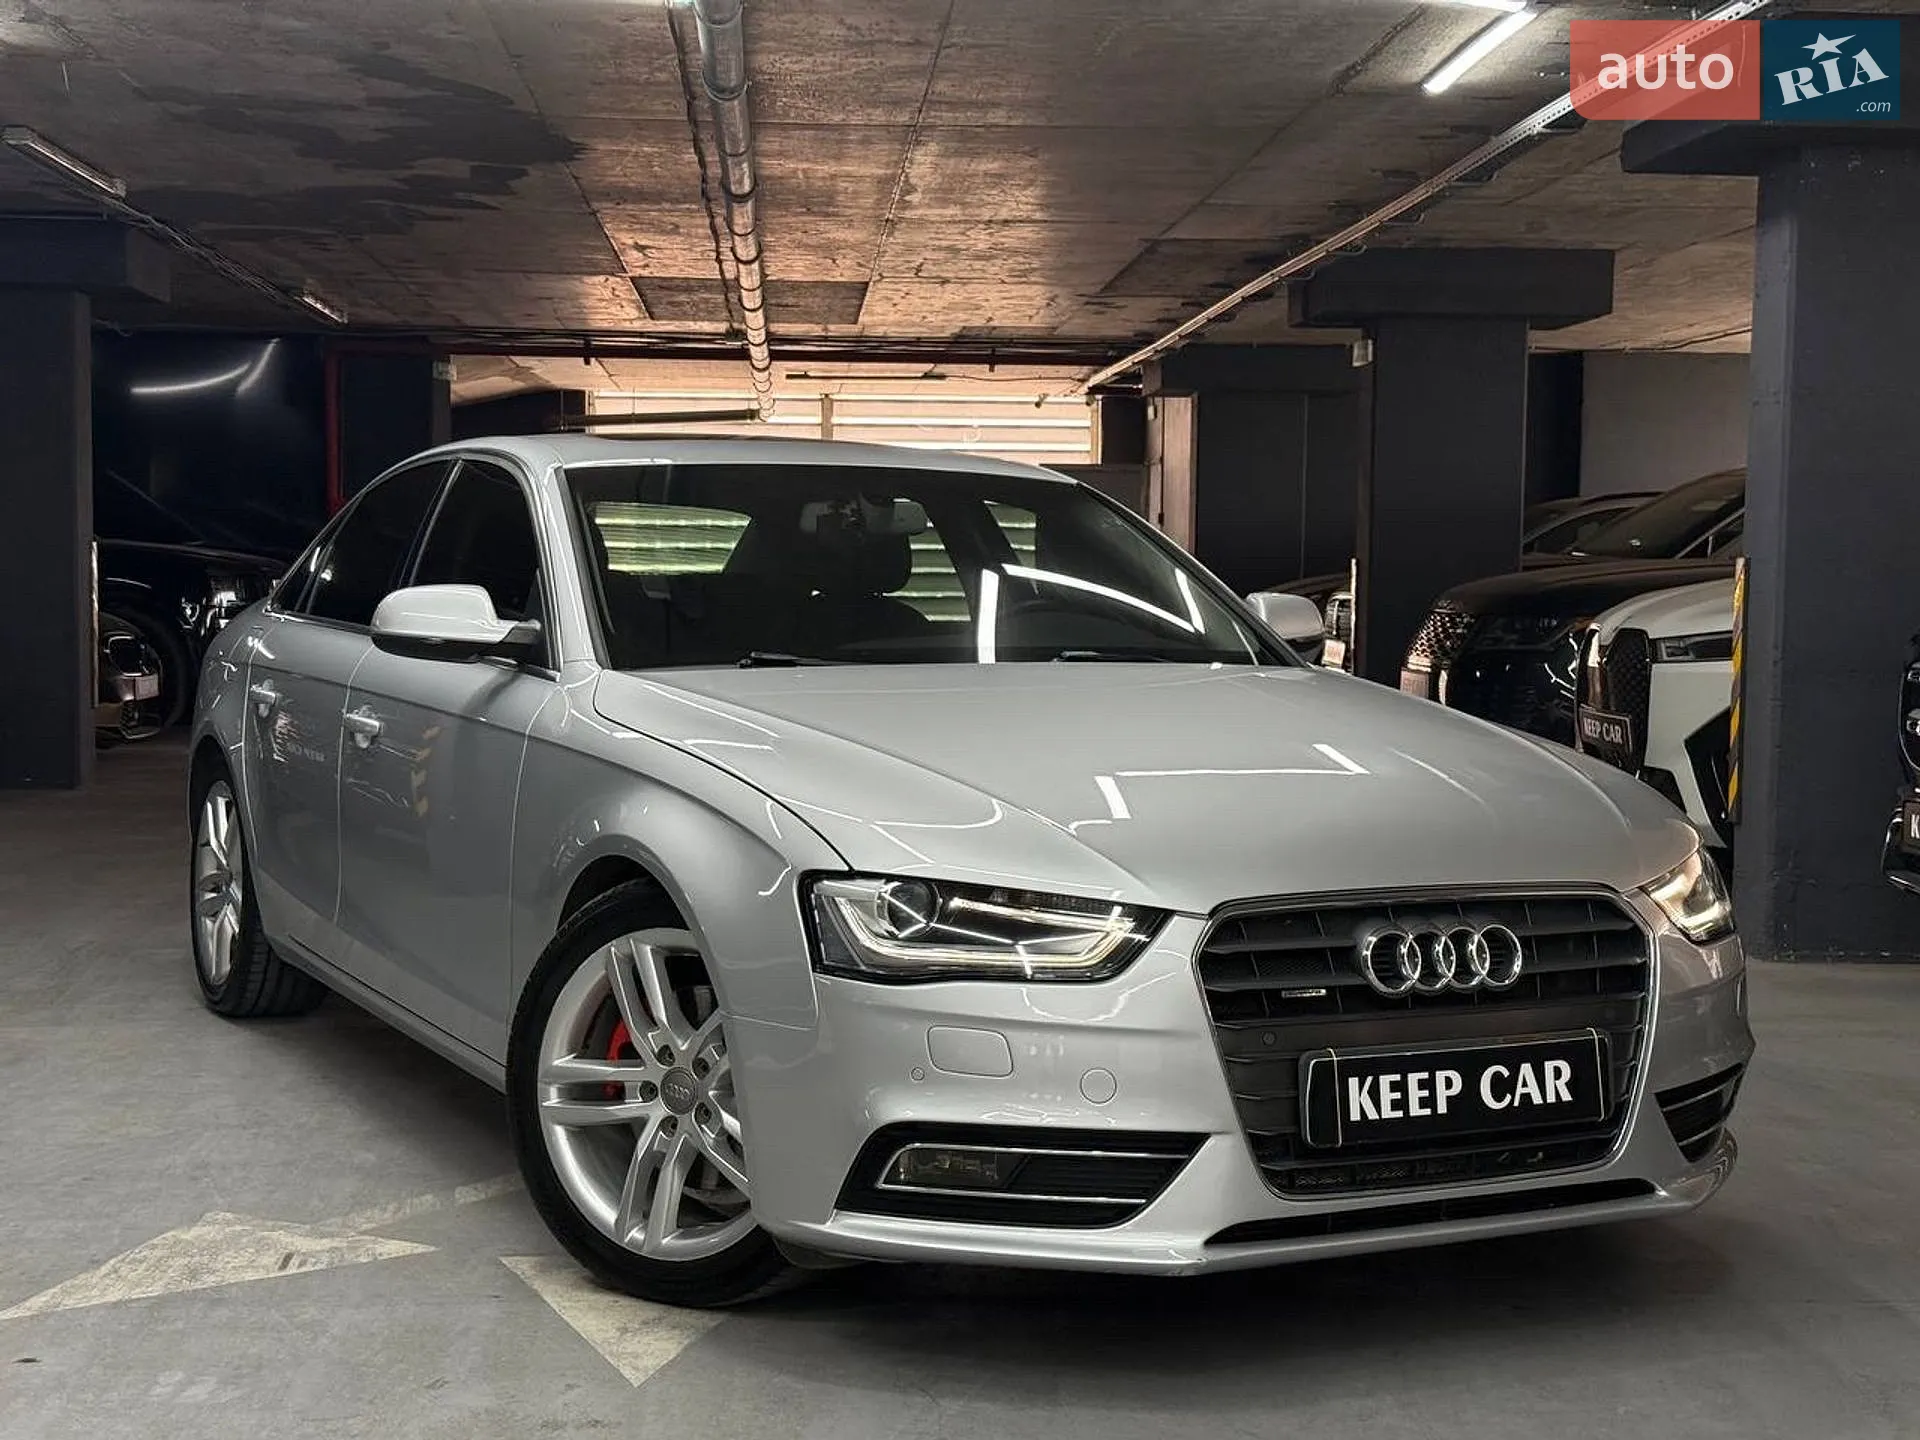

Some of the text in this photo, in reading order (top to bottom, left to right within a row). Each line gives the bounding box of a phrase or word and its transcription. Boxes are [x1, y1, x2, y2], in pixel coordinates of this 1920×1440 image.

[1602, 722, 1623, 745] CAR
[1347, 1058, 1574, 1122] KEEP CAR
